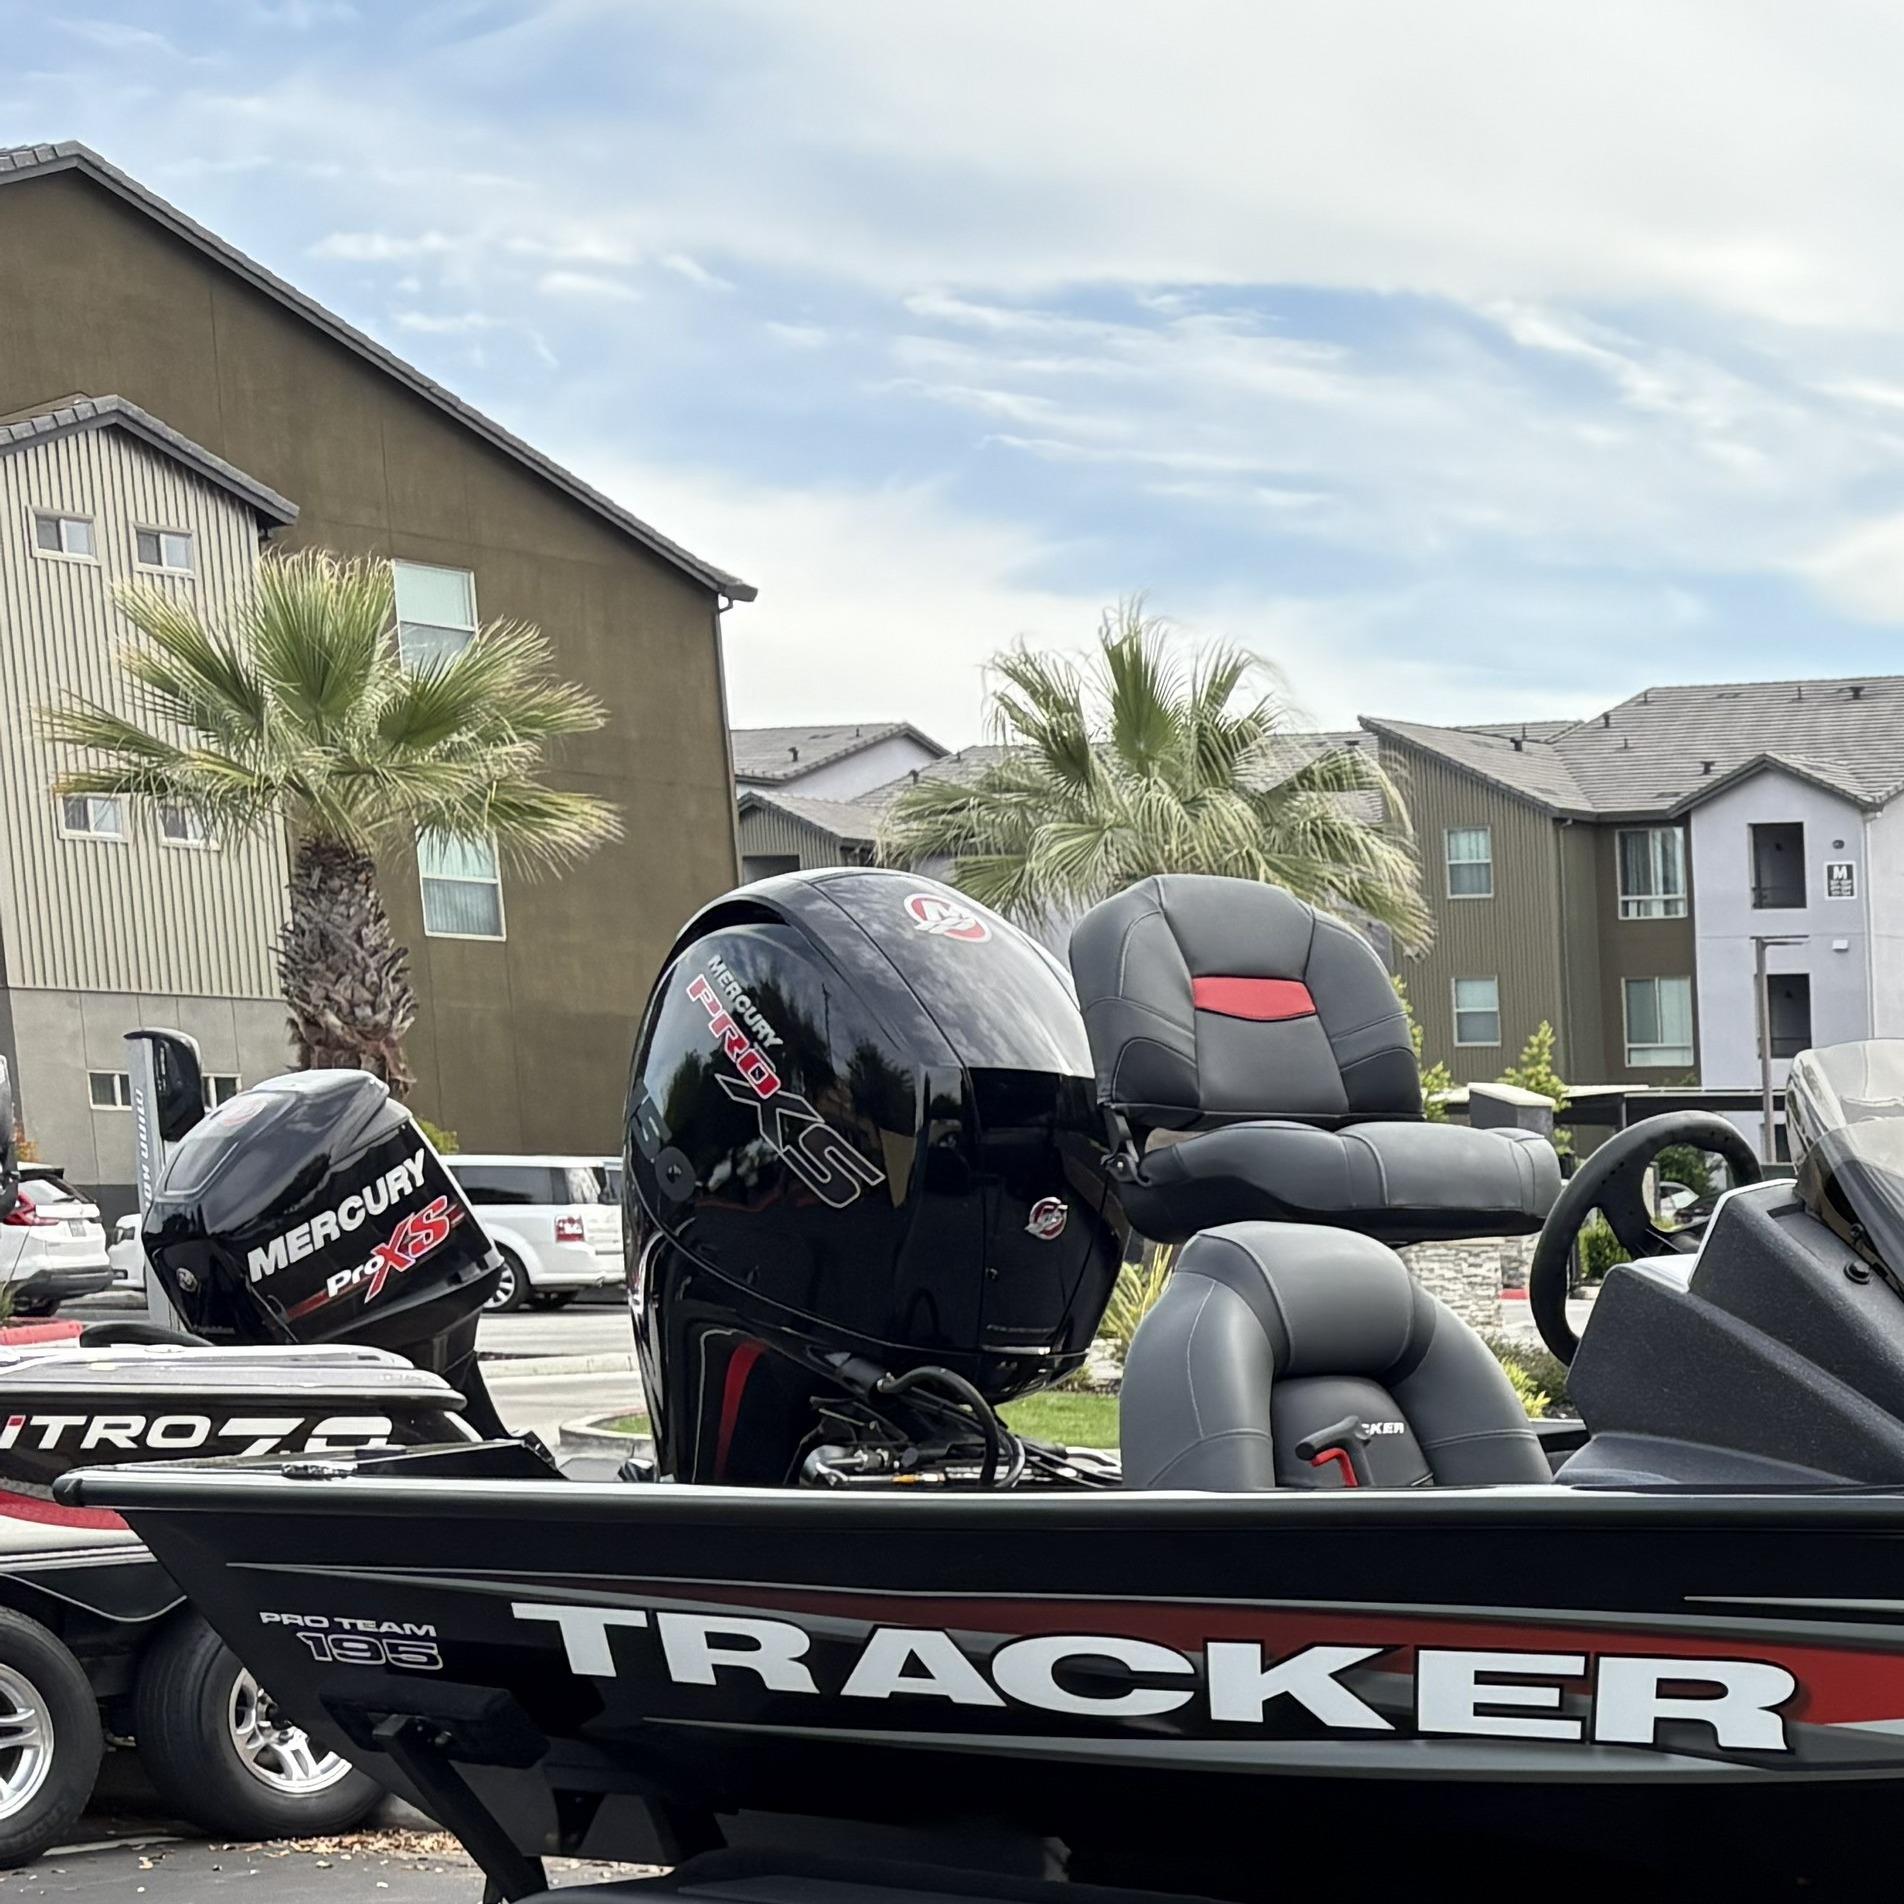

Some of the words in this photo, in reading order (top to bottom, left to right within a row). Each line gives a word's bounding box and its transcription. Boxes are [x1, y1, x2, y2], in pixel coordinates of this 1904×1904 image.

[686, 974, 781, 1100] PRO
[708, 954, 783, 1049] MERCURY
[714, 1073, 886, 1209] XS
[247, 1148, 426, 1283] MERCURY
[0, 1415, 211, 1449] ITRO
[259, 1612, 330, 1628] PRO
[334, 1617, 437, 1637] TEAM
[296, 1632, 444, 1670] 195
[511, 1600, 1797, 1752] TRACKER
